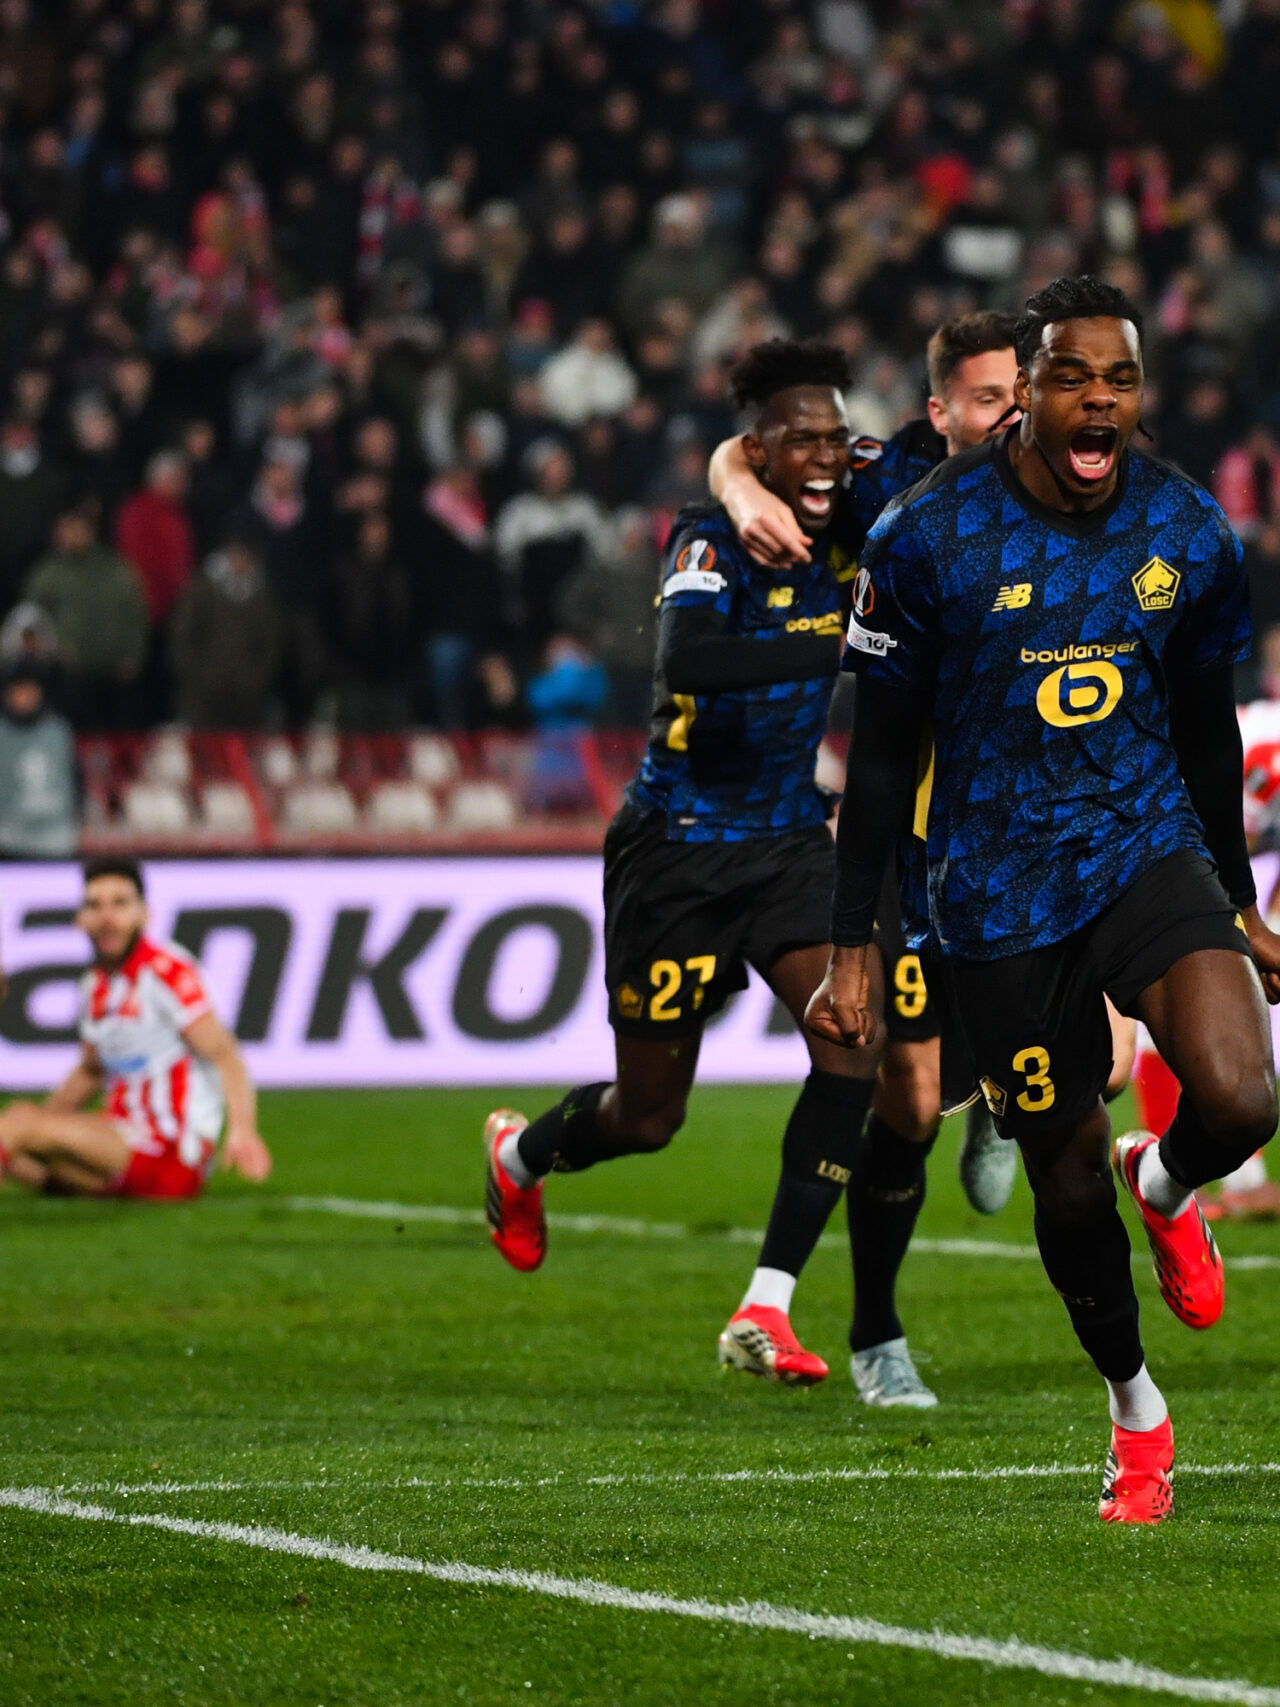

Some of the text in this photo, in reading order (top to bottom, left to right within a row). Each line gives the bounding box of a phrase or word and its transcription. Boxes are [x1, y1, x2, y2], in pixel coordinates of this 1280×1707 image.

[1144, 596, 1170, 607] LOSC
[1020, 640, 1141, 664] boulanger
[650, 955, 717, 1021] 27
[894, 954, 928, 1018] 9
[1012, 1045, 1056, 1113] 3
